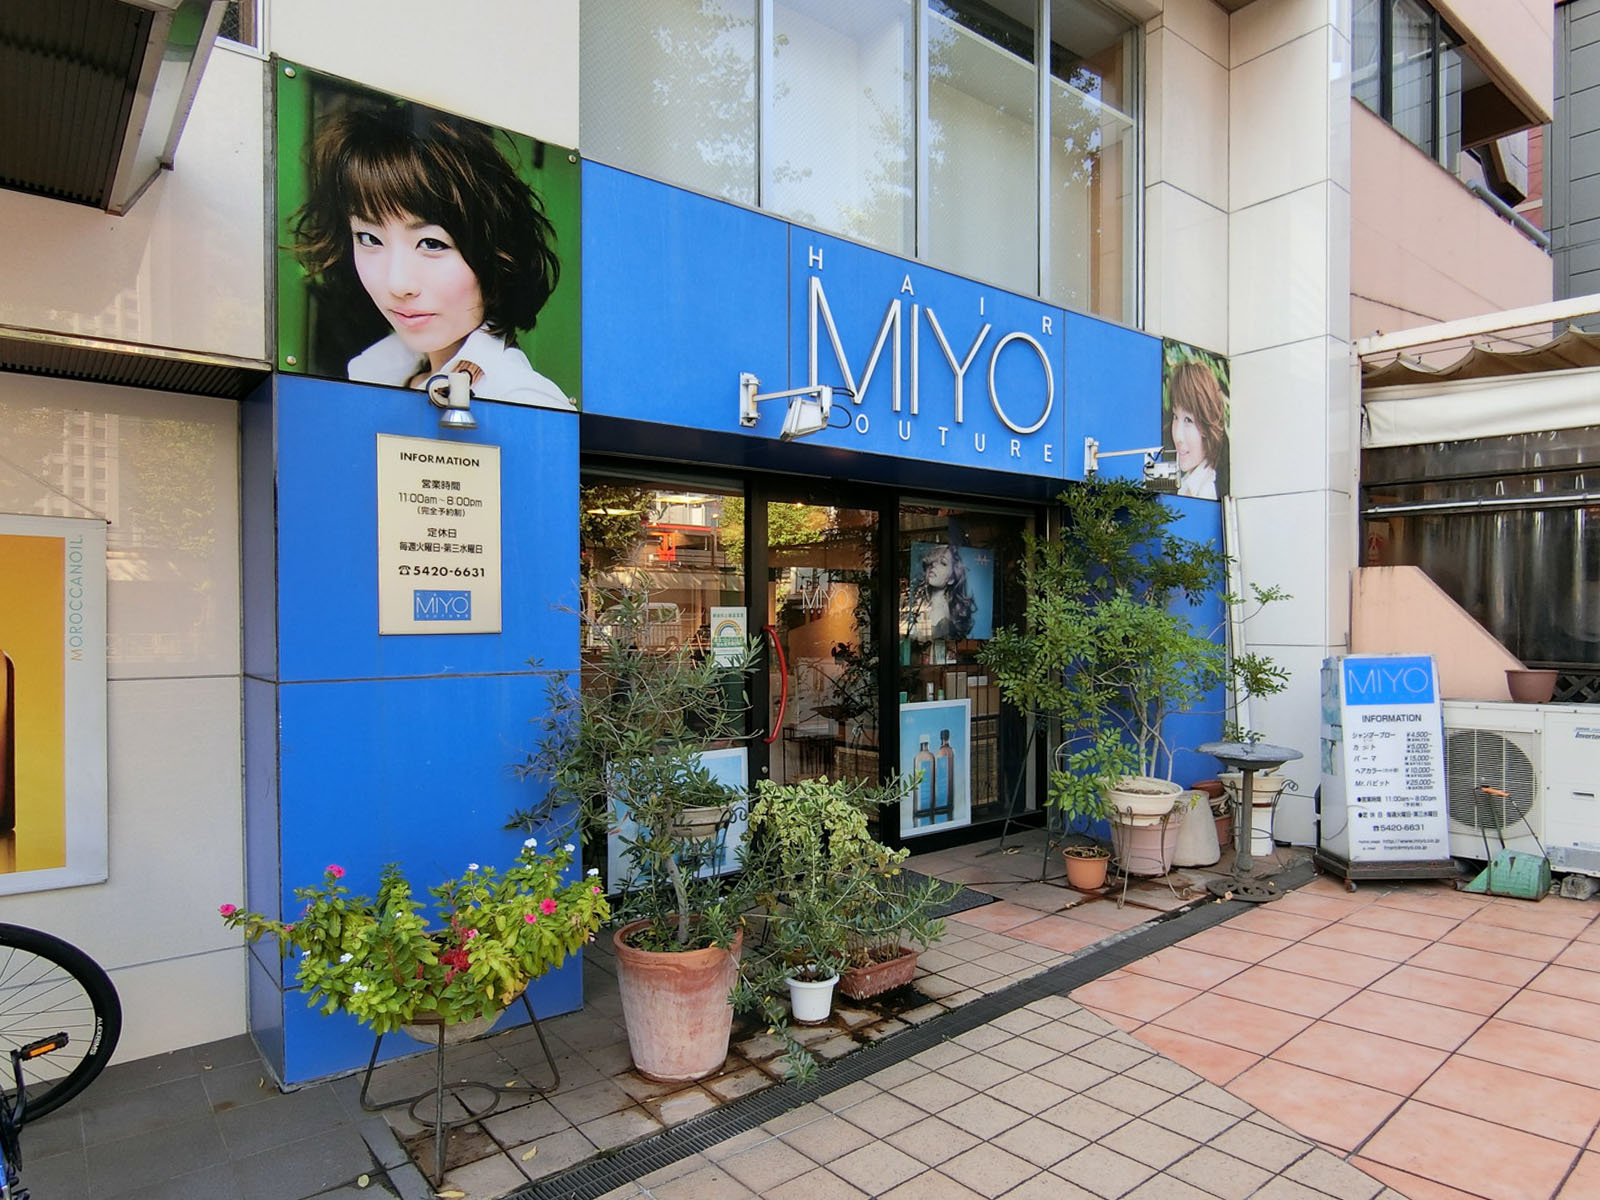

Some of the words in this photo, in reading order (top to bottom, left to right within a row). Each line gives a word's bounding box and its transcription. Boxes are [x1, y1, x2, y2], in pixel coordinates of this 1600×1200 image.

[808, 246, 1052, 336] HAIR
[808, 275, 1054, 434] MIYO
[855, 413, 1053, 463] OUTURE
[400, 452, 480, 467] INFORMATION
[421, 479, 461, 491] 営業時間
[427, 528, 457, 539] 定休日
[413, 566, 485, 577] 5420-6631
[416, 597, 469, 614] MIYO
[802, 587, 848, 609] MIYO
[1348, 667, 1430, 694] MIYO
[1361, 713, 1422, 723] INFORMATION
[1380, 824, 1425, 832] 5420-6631
